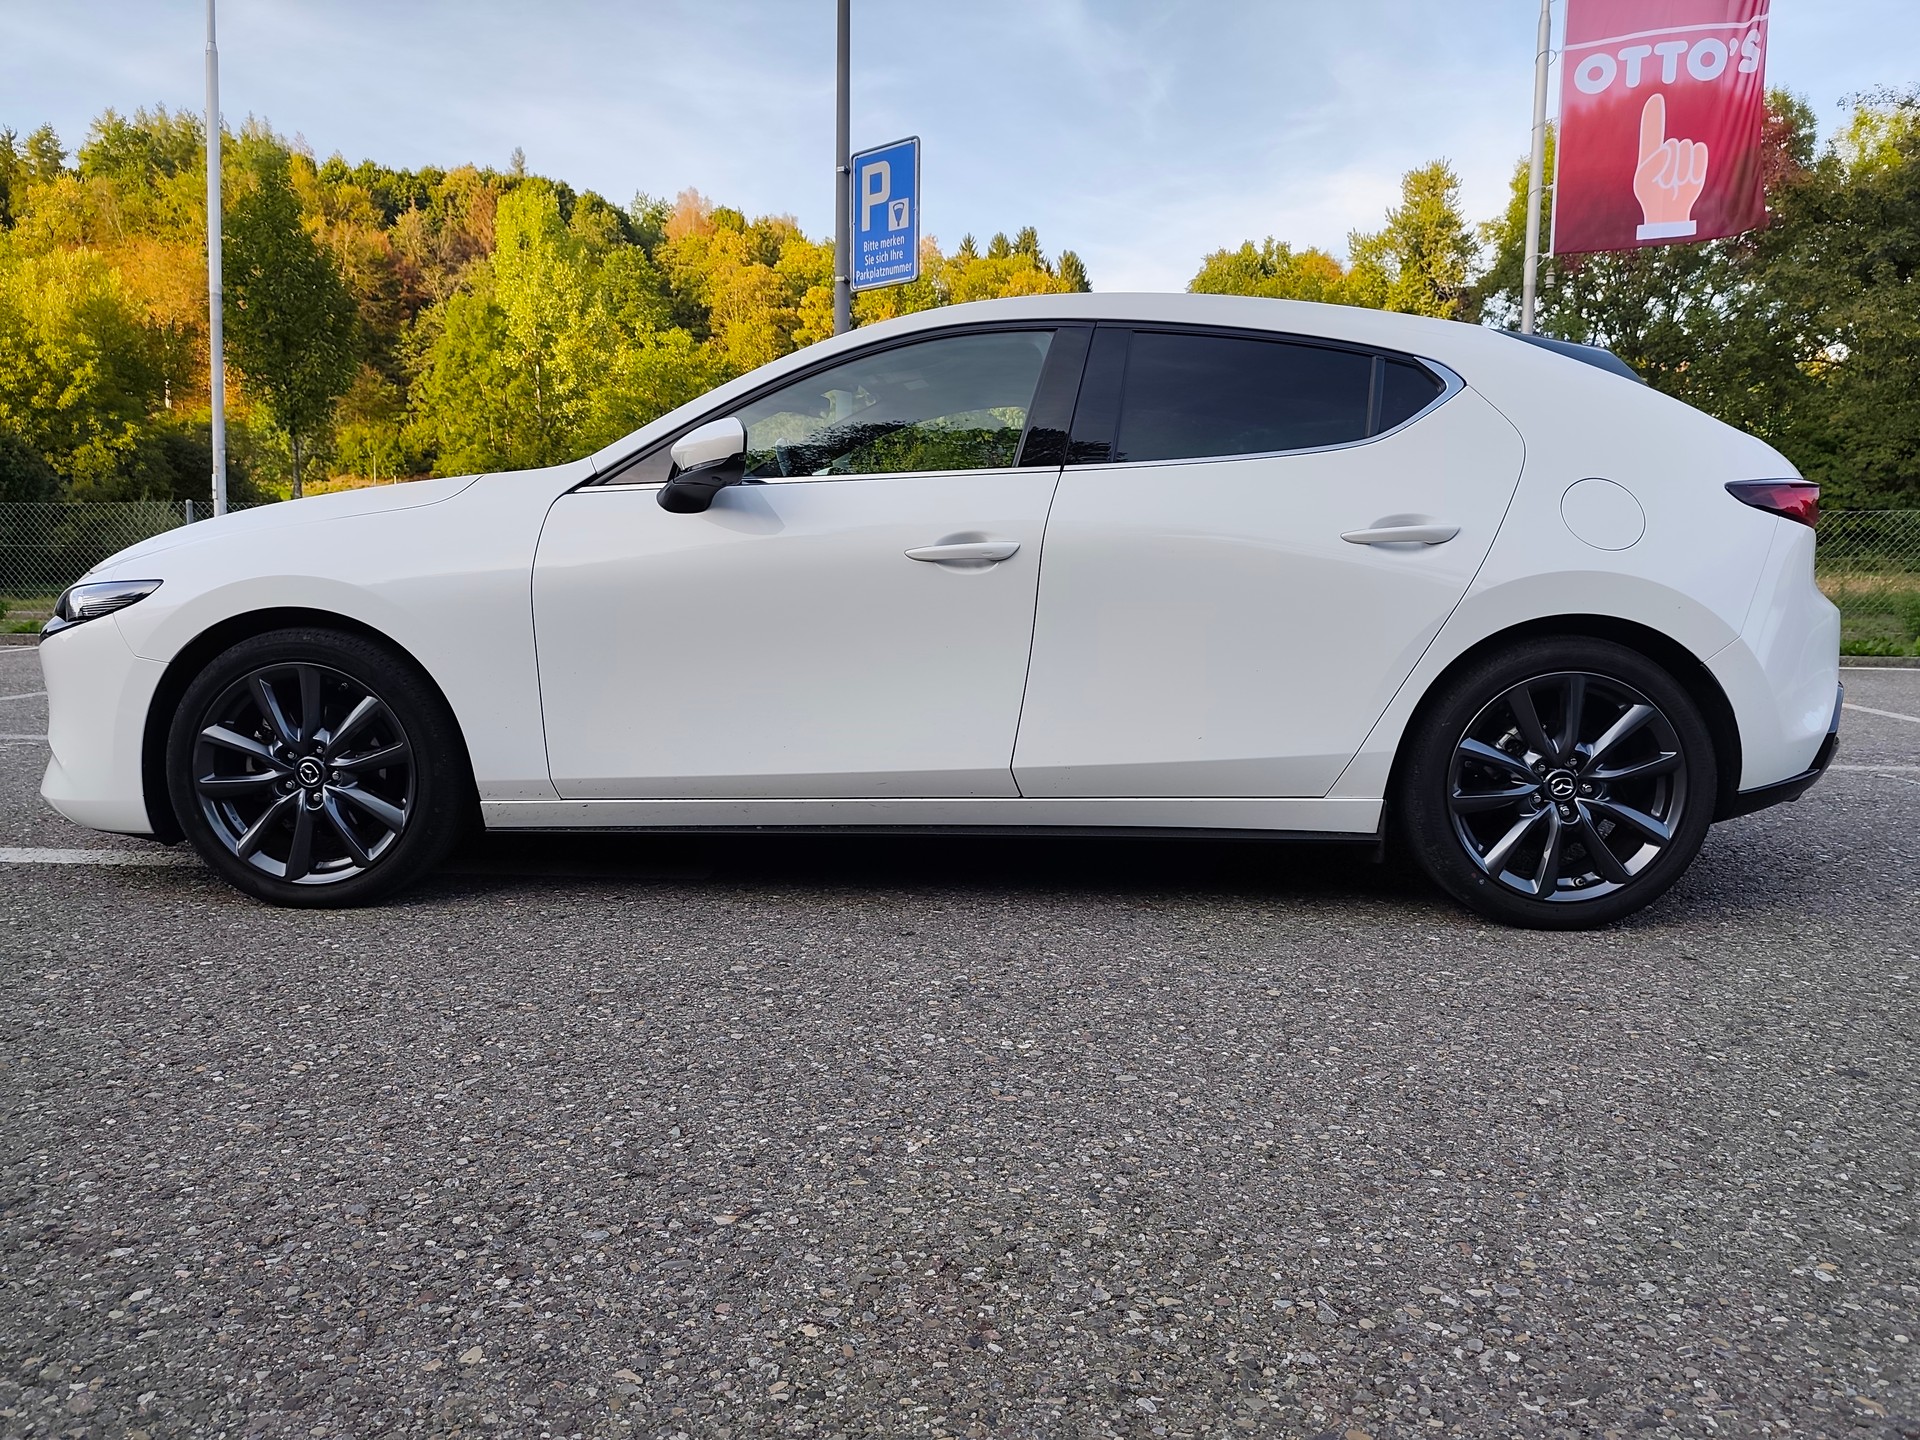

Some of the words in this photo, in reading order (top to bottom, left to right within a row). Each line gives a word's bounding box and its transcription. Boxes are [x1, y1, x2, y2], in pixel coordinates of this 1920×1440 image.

[1574, 29, 1761, 95] OTTO'S
[862, 160, 891, 232] P
[864, 240, 879, 252] Bitte
[880, 235, 904, 249] merken
[865, 255, 875, 266] Sie
[876, 252, 888, 264] sich
[890, 249, 903, 261] Ihre
[856, 263, 912, 281] Parkplatznummer
